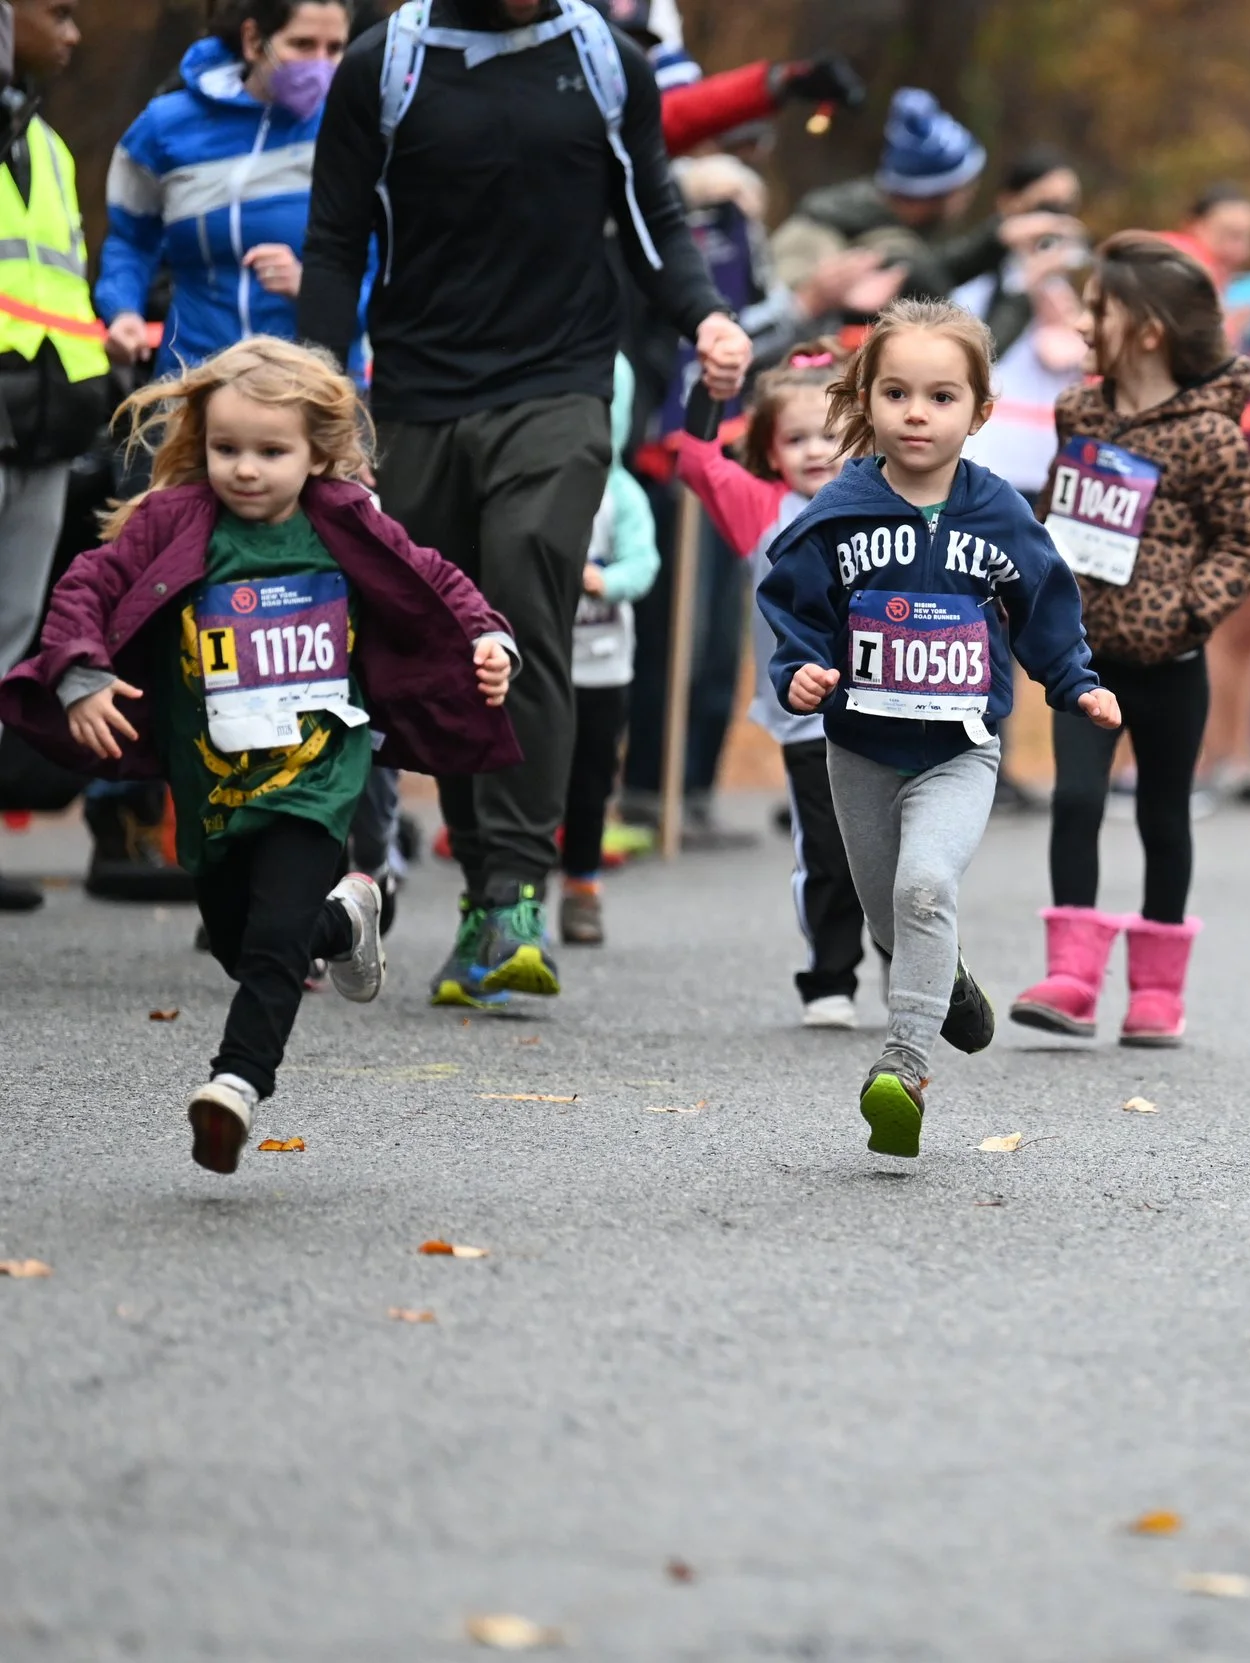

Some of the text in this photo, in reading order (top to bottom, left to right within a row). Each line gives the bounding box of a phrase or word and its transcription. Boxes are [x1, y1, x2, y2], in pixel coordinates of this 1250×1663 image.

[1059, 474, 1141, 529] I 10421
[837, 524, 916, 586] BROO
[208, 622, 335, 677] I 11126
[855, 639, 984, 685] I 10503
